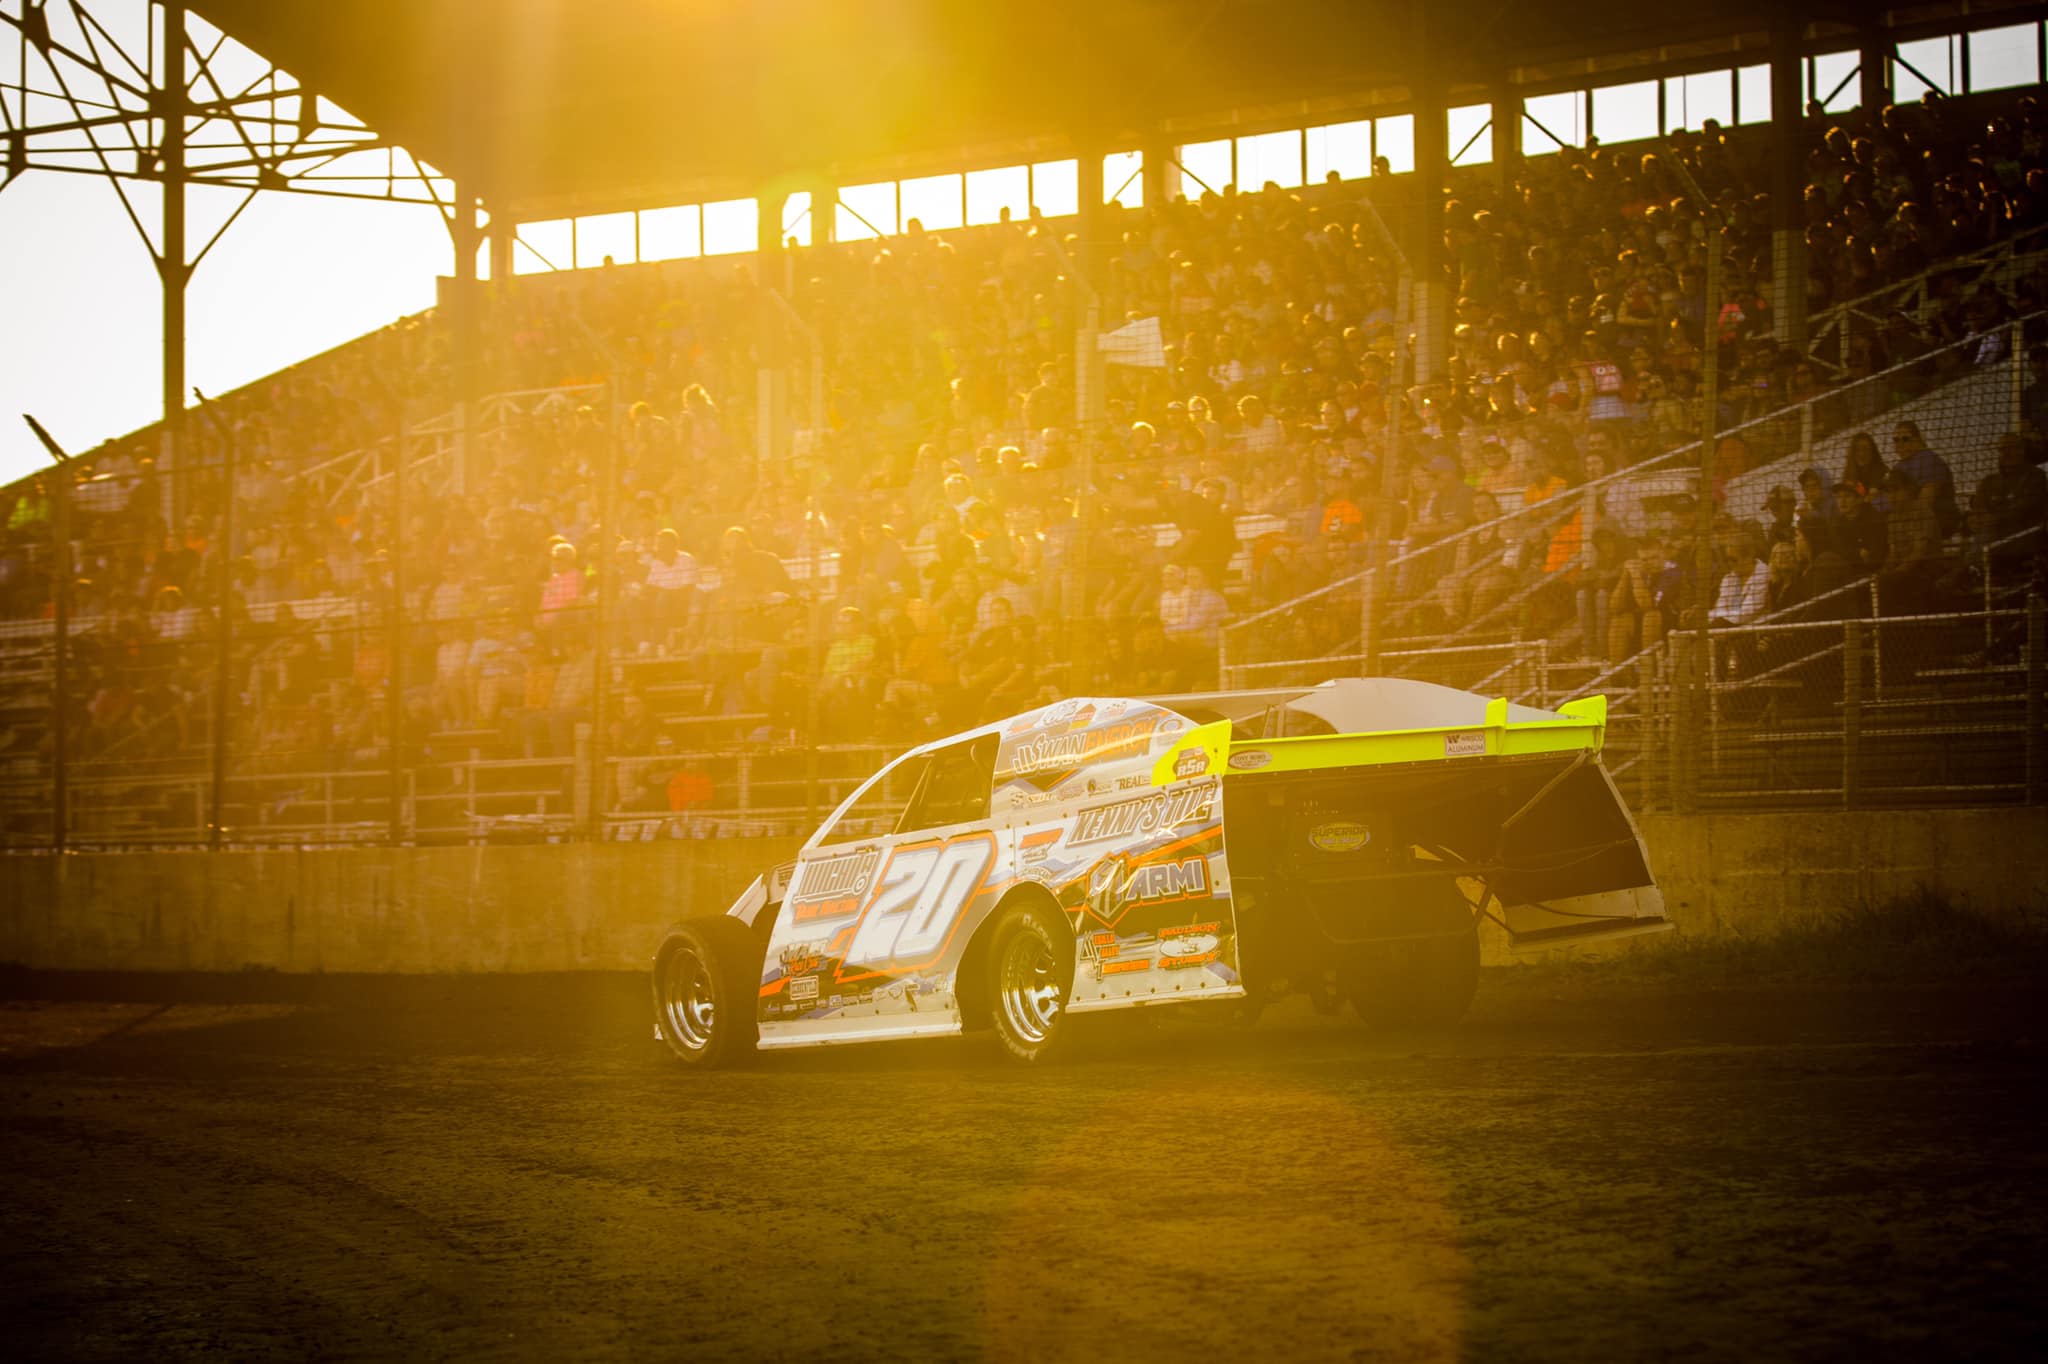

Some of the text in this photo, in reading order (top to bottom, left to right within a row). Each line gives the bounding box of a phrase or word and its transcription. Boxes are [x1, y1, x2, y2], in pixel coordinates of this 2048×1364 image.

[1031, 733, 1088, 769] SWAN
[1065, 781, 1218, 848] KENNY'S TILE
[843, 839, 992, 966] 20
[1125, 859, 1206, 901] ARMI
